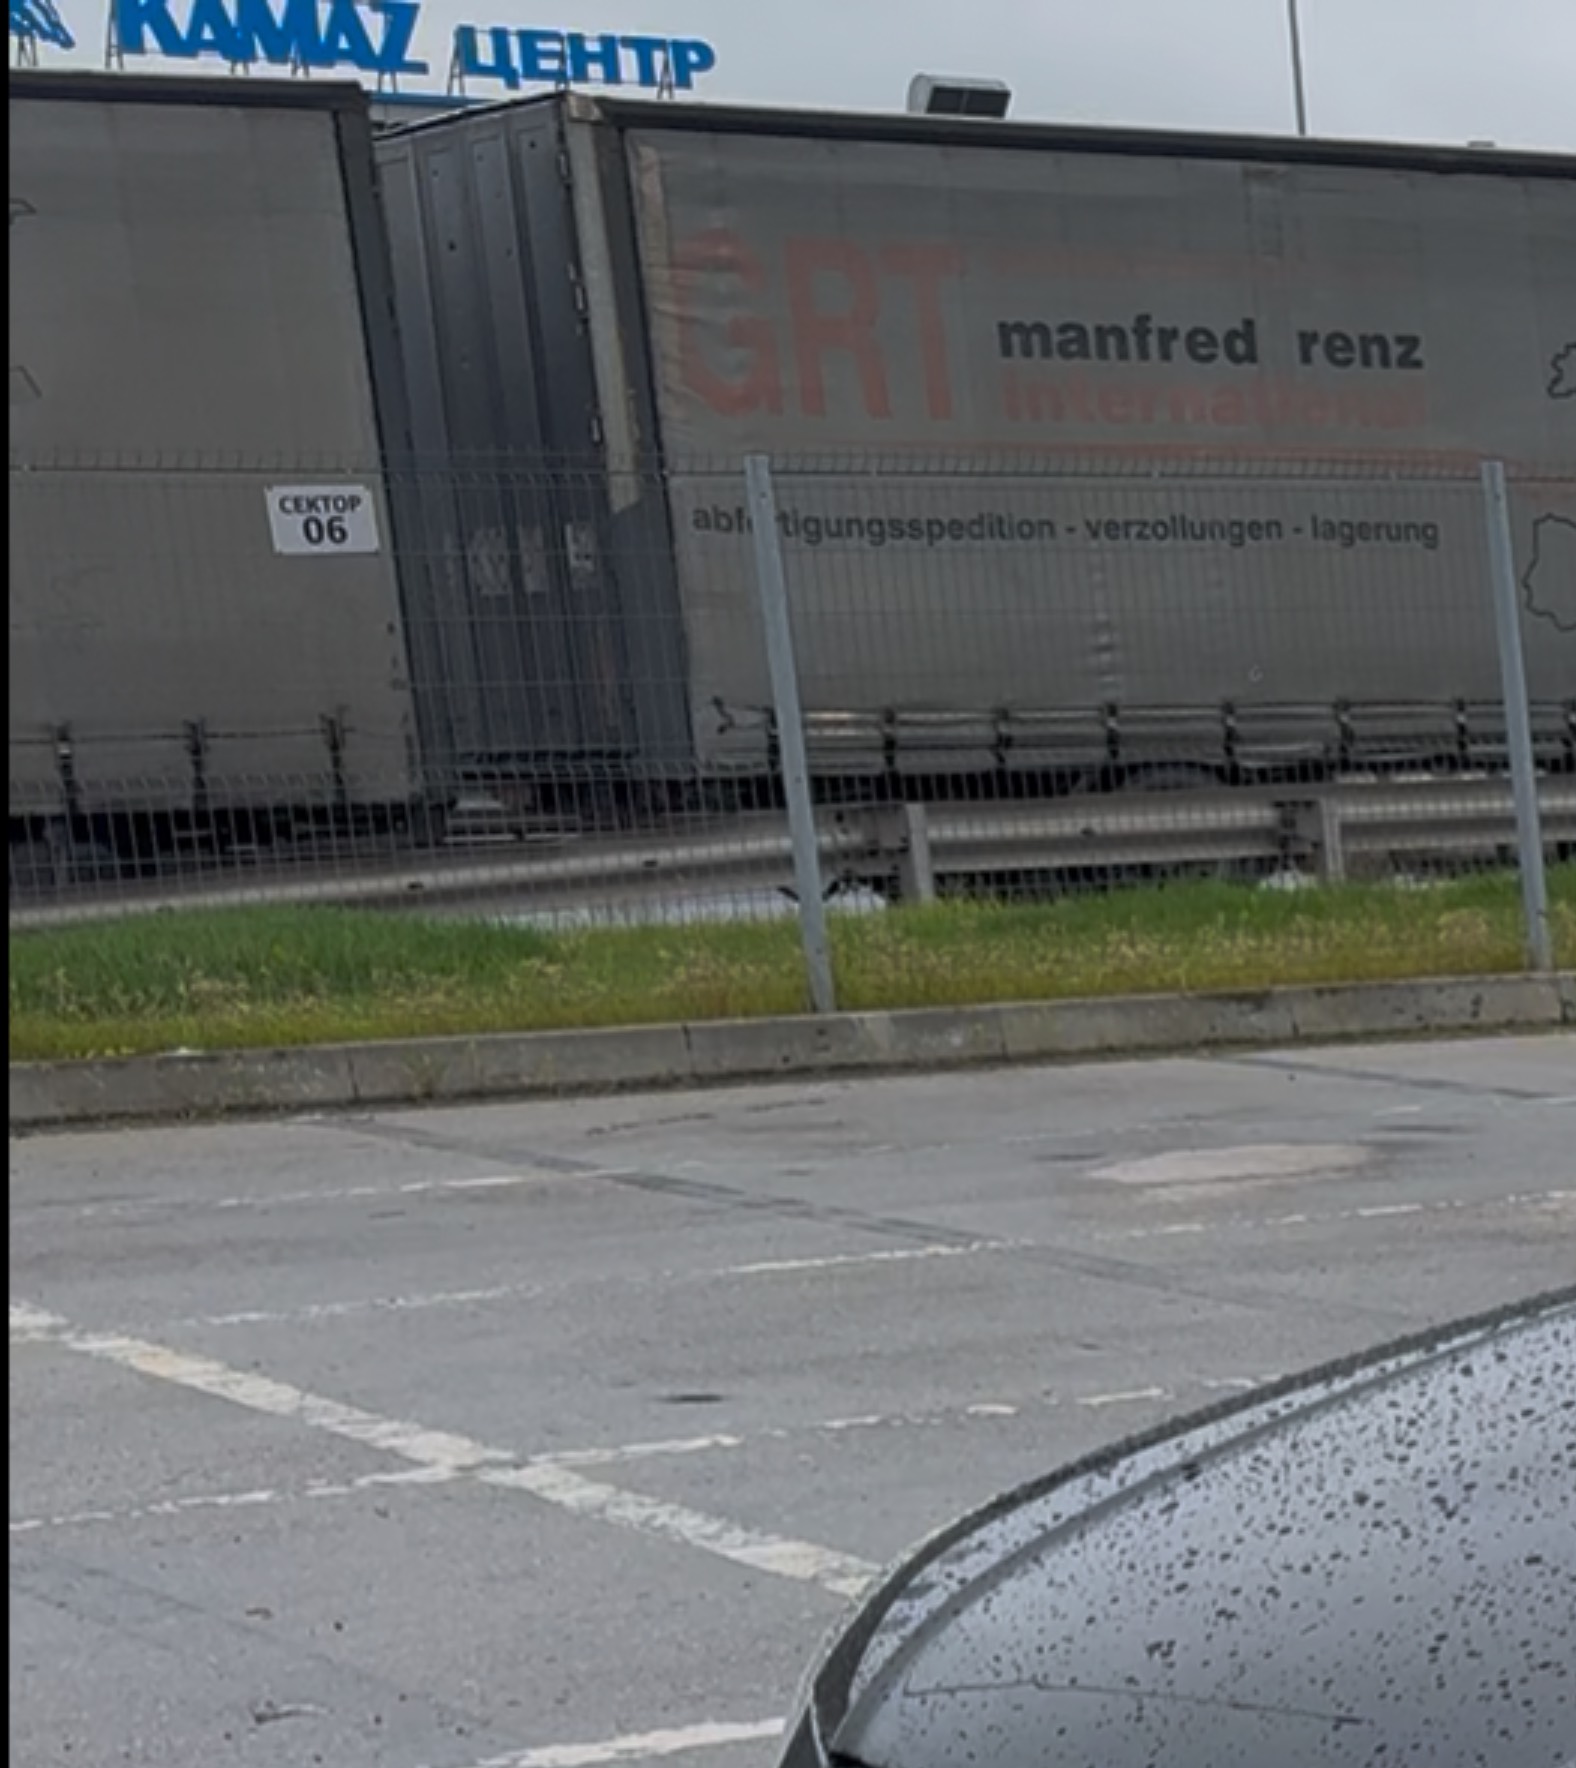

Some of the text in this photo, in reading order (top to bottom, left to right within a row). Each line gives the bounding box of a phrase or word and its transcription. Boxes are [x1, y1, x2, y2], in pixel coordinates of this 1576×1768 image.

[117, 0, 715, 89] KAMAZ ЦЕНТР
[672, 228, 965, 420] GRT
[997, 314, 1424, 369] manfred renz
[279, 494, 361, 515] СЕКТОР
[303, 516, 348, 545] 06
[1085, 514, 1284, 549] verzollungen
[1312, 515, 1440, 550] lagerung
